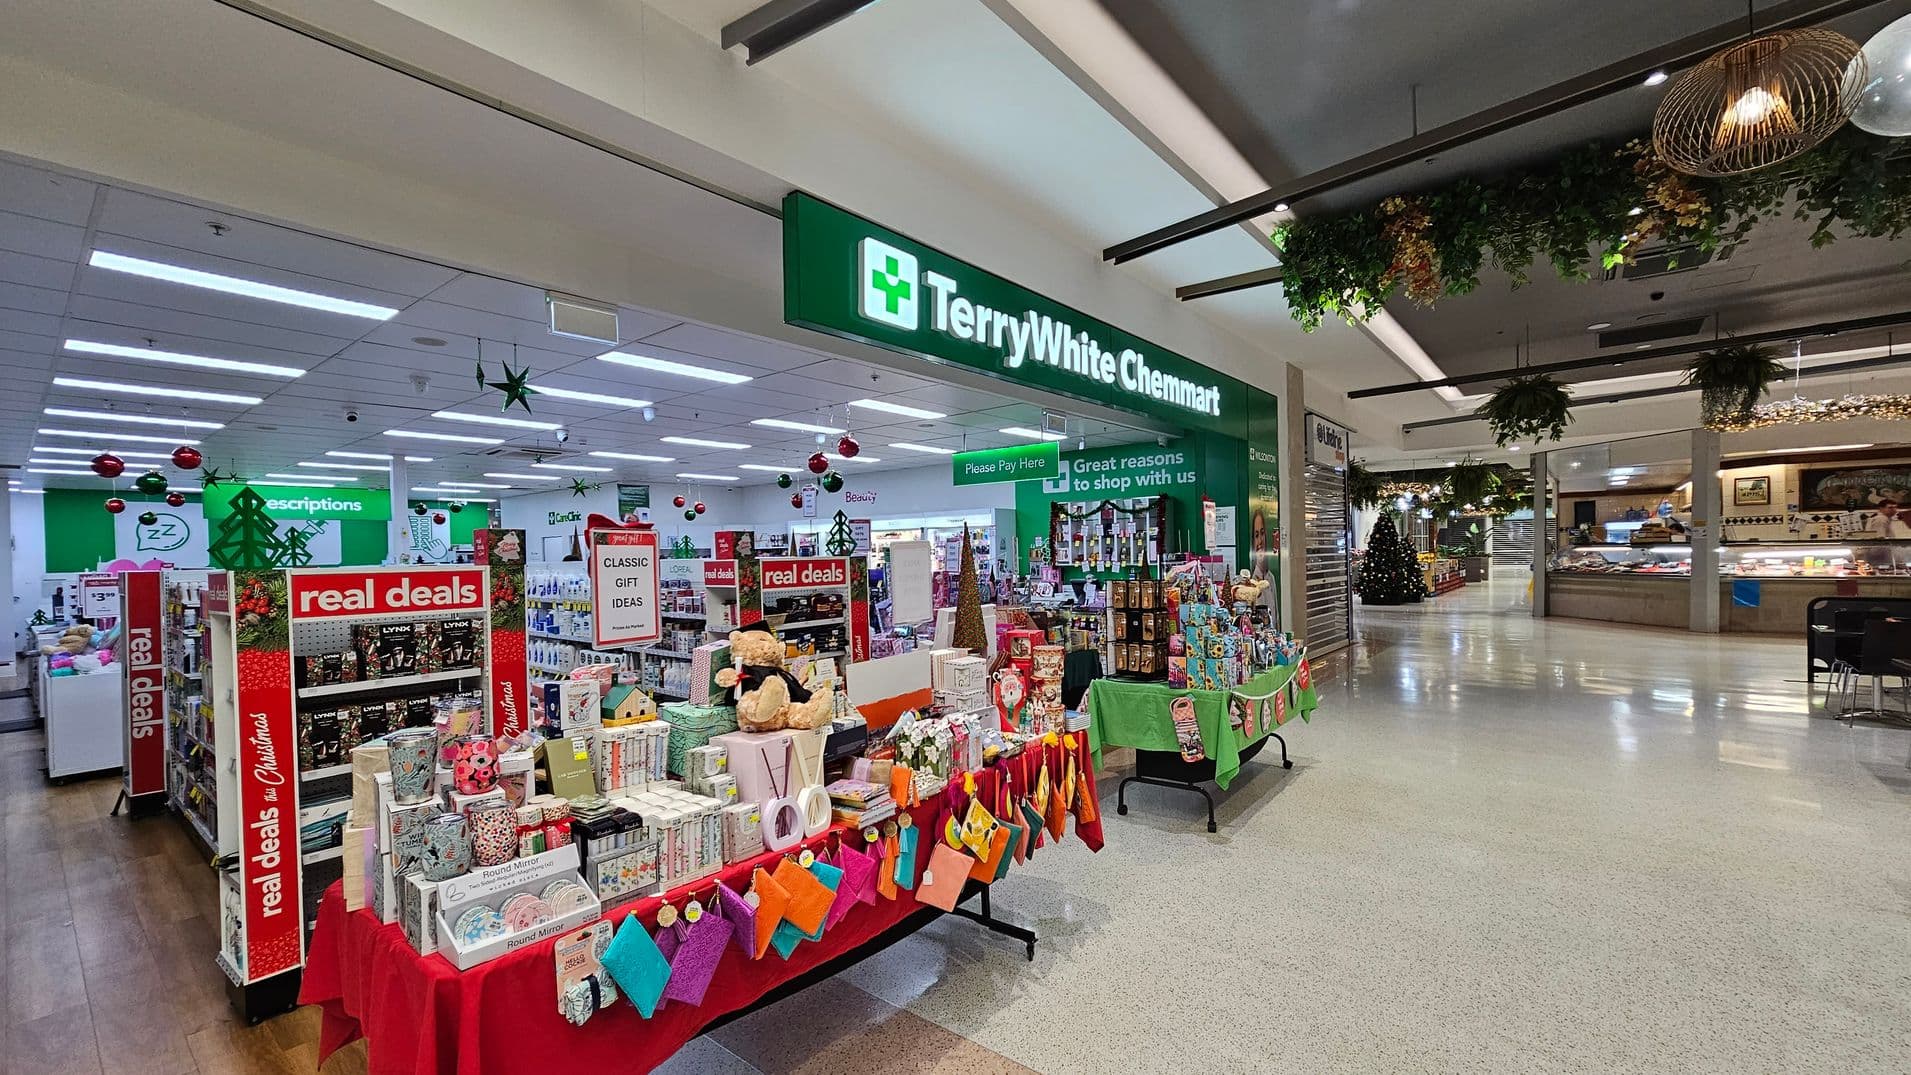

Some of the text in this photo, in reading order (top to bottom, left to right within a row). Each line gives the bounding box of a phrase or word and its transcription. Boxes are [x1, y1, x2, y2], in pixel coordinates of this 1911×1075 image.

[921, 268, 1221, 417] TerryWhite Chemmart
[965, 457, 1045, 475] Please Pay Here
[1073, 452, 1184, 474] Great reasons
[1073, 469, 1196, 492] to shop with us
[603, 557, 649, 568] CLASSIC
[615, 577, 639, 588] GIFT
[717, 567, 734, 579] deals
[764, 562, 844, 585] real deals
[300, 575, 478, 612] real deals
[612, 597, 643, 608] IDEAS
[382, 625, 411, 634] LYNX
[443, 620, 469, 628] LYNX
[130, 627, 163, 739] real deals
[363, 704, 385, 713] LYNX
[408, 698, 428, 706] LYNX
[500, 681, 521, 740] Christmas
[313, 711, 336, 720] LYNX
[249, 712, 286, 918] real deals this Christmas
[482, 857, 540, 879] Round Mirror
[506, 922, 565, 949] Round Mirror
